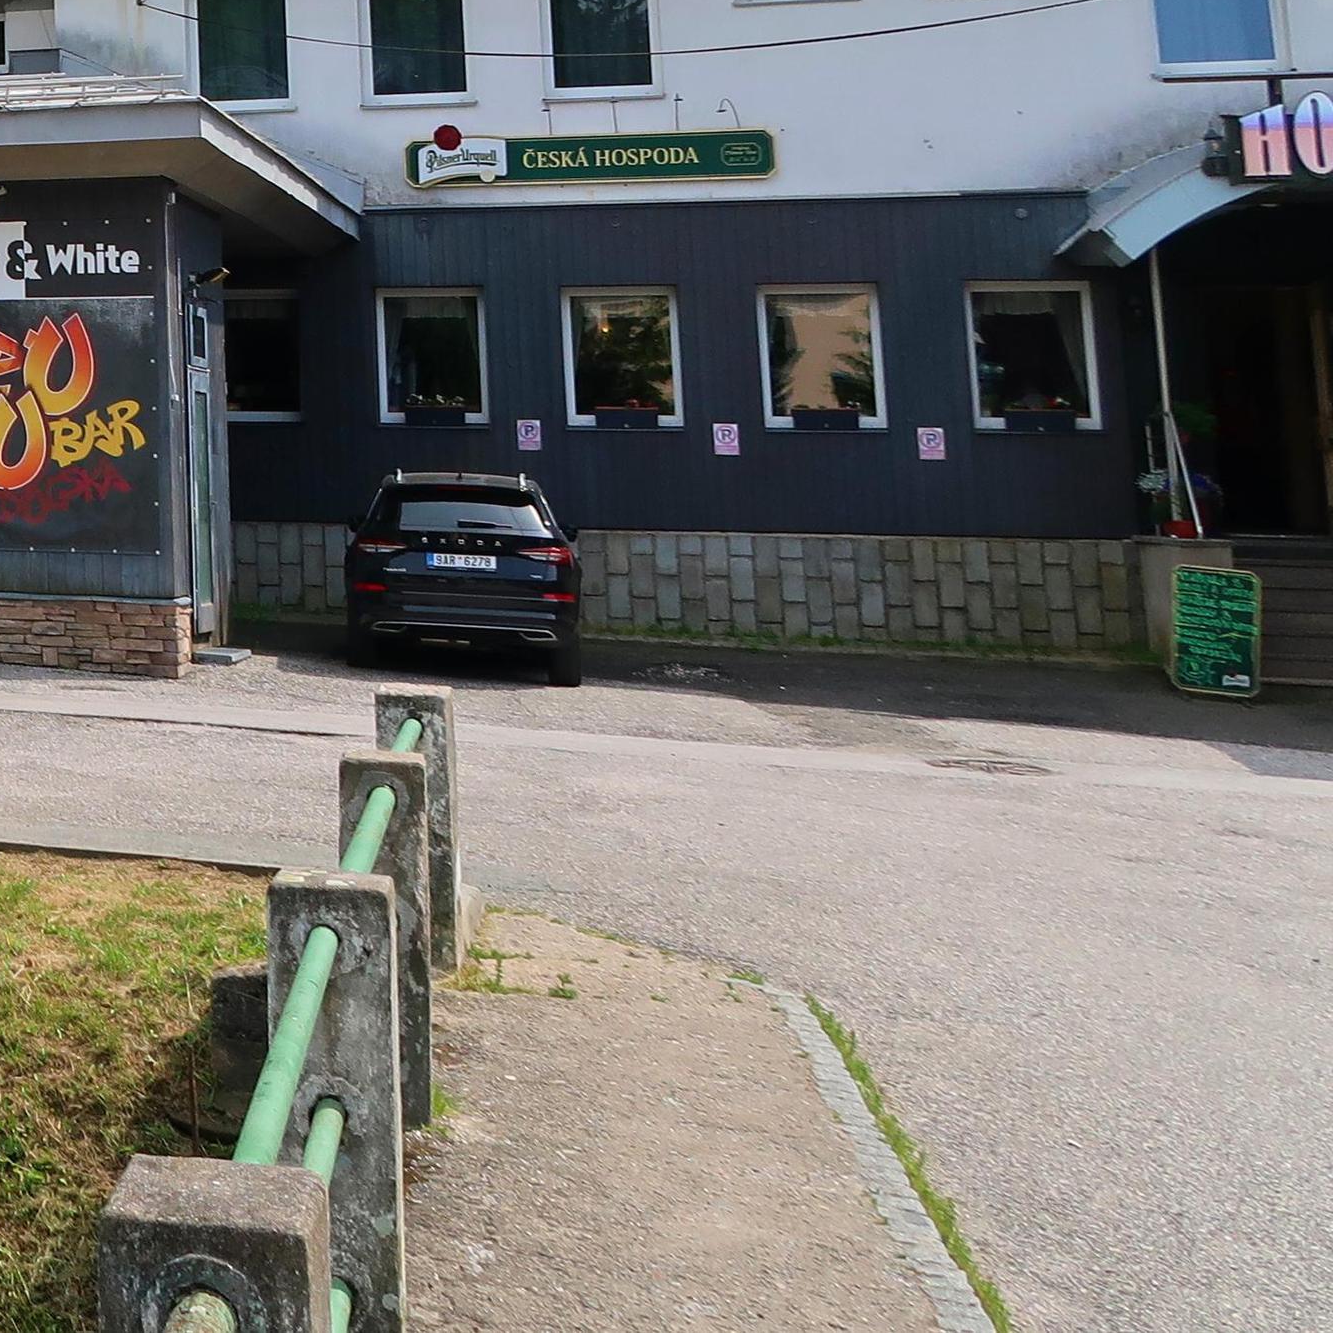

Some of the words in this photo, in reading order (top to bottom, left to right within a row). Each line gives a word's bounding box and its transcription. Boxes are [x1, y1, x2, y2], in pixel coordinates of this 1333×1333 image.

[521, 147, 588, 169] ČESKÁ
[594, 147, 699, 168] HOSPODA
[5, 240, 42, 280] &
[45, 244, 140, 276] White
[50, 400, 146, 467] BAR
[436, 555, 455, 565] 9AR
[464, 556, 492, 567] 6278
